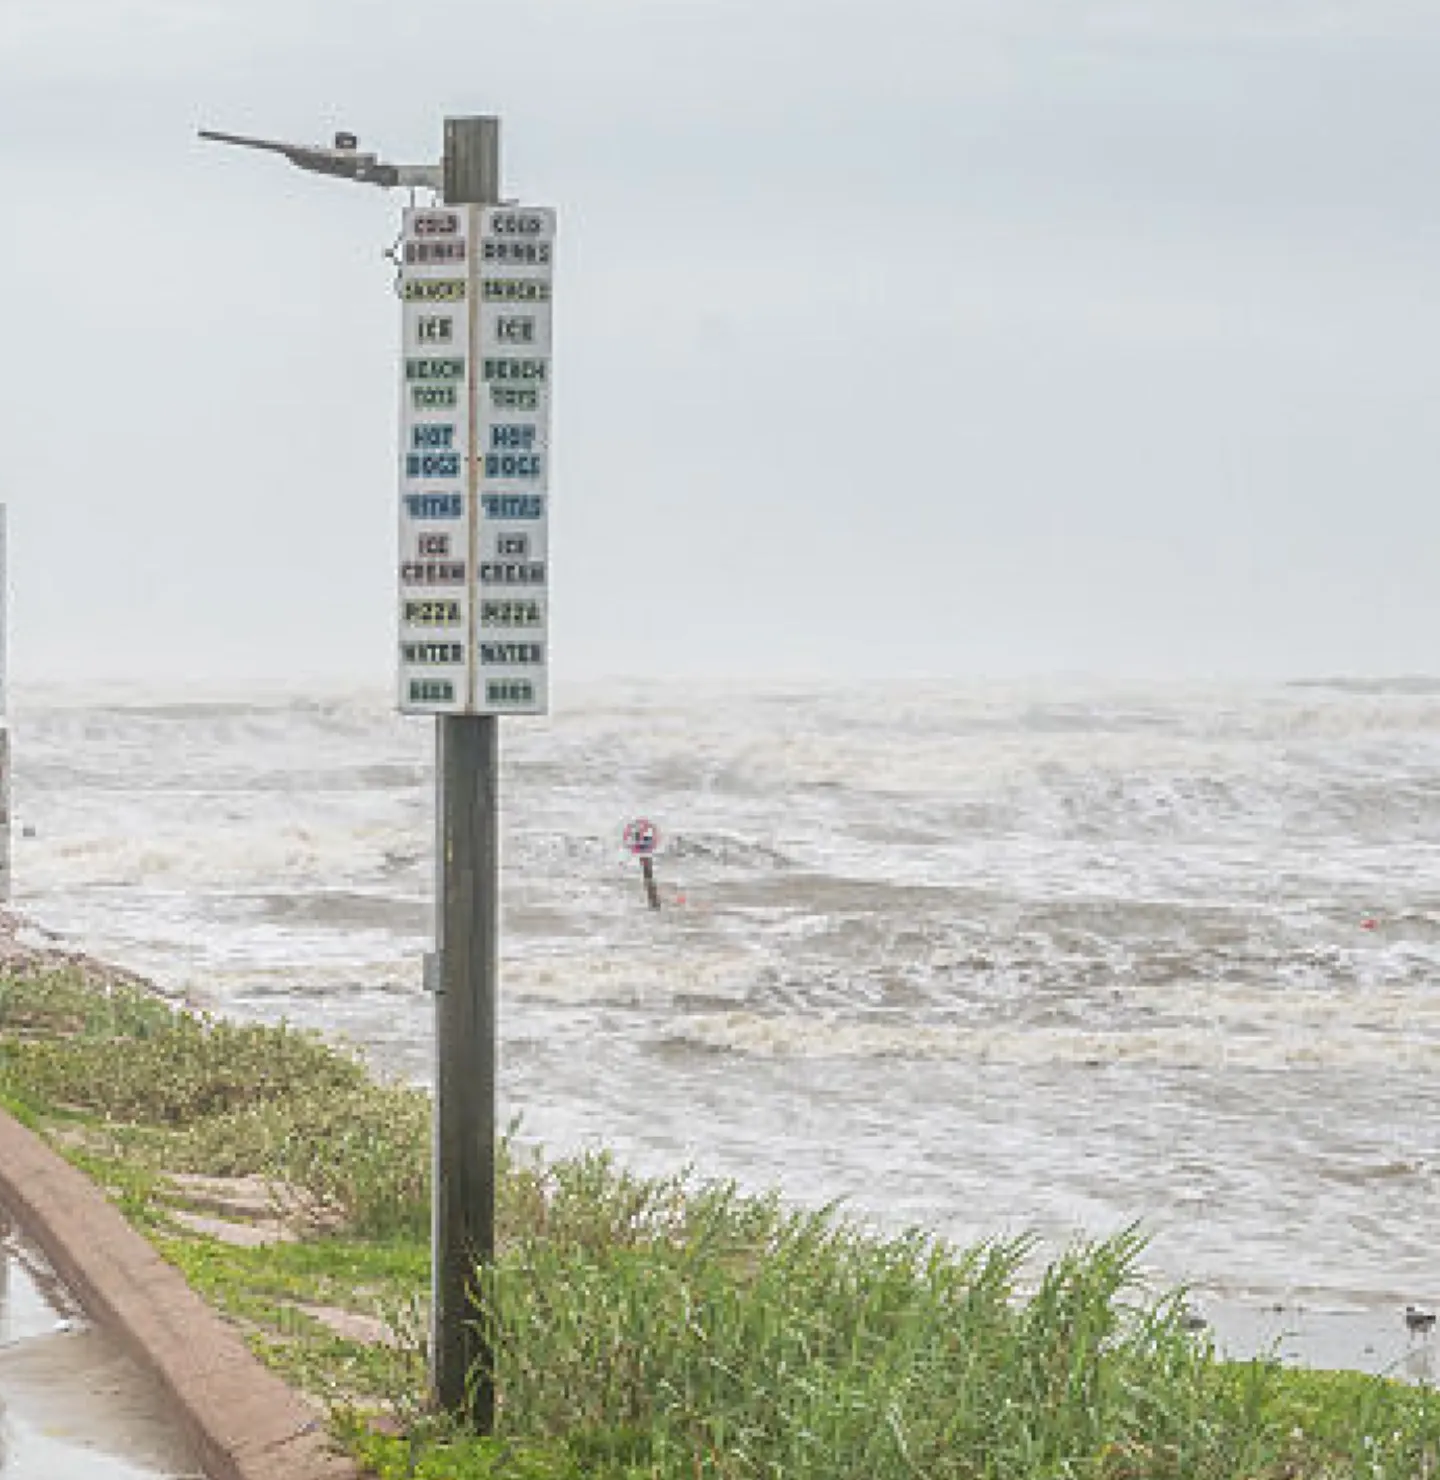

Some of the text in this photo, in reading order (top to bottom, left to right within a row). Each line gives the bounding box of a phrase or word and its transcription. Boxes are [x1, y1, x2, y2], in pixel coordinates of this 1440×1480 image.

[418, 318, 452, 340] ICE
[497, 318, 533, 341] ICE
[406, 360, 465, 379] BEACH
[484, 360, 546, 379] BEACH
[413, 425, 453, 448] HOT
[493, 425, 536, 448] HOT
[406, 454, 459, 477] DOGS
[485, 454, 541, 477] DOGS
[419, 535, 449, 553] ICE
[497, 535, 526, 553] ICE
[402, 564, 465, 583] CREAM
[481, 564, 545, 583] CREAM
[404, 602, 459, 621] PIZZA
[482, 602, 541, 621] PIZZA
[403, 643, 464, 663] WATER
[480, 643, 543, 663] WATER
